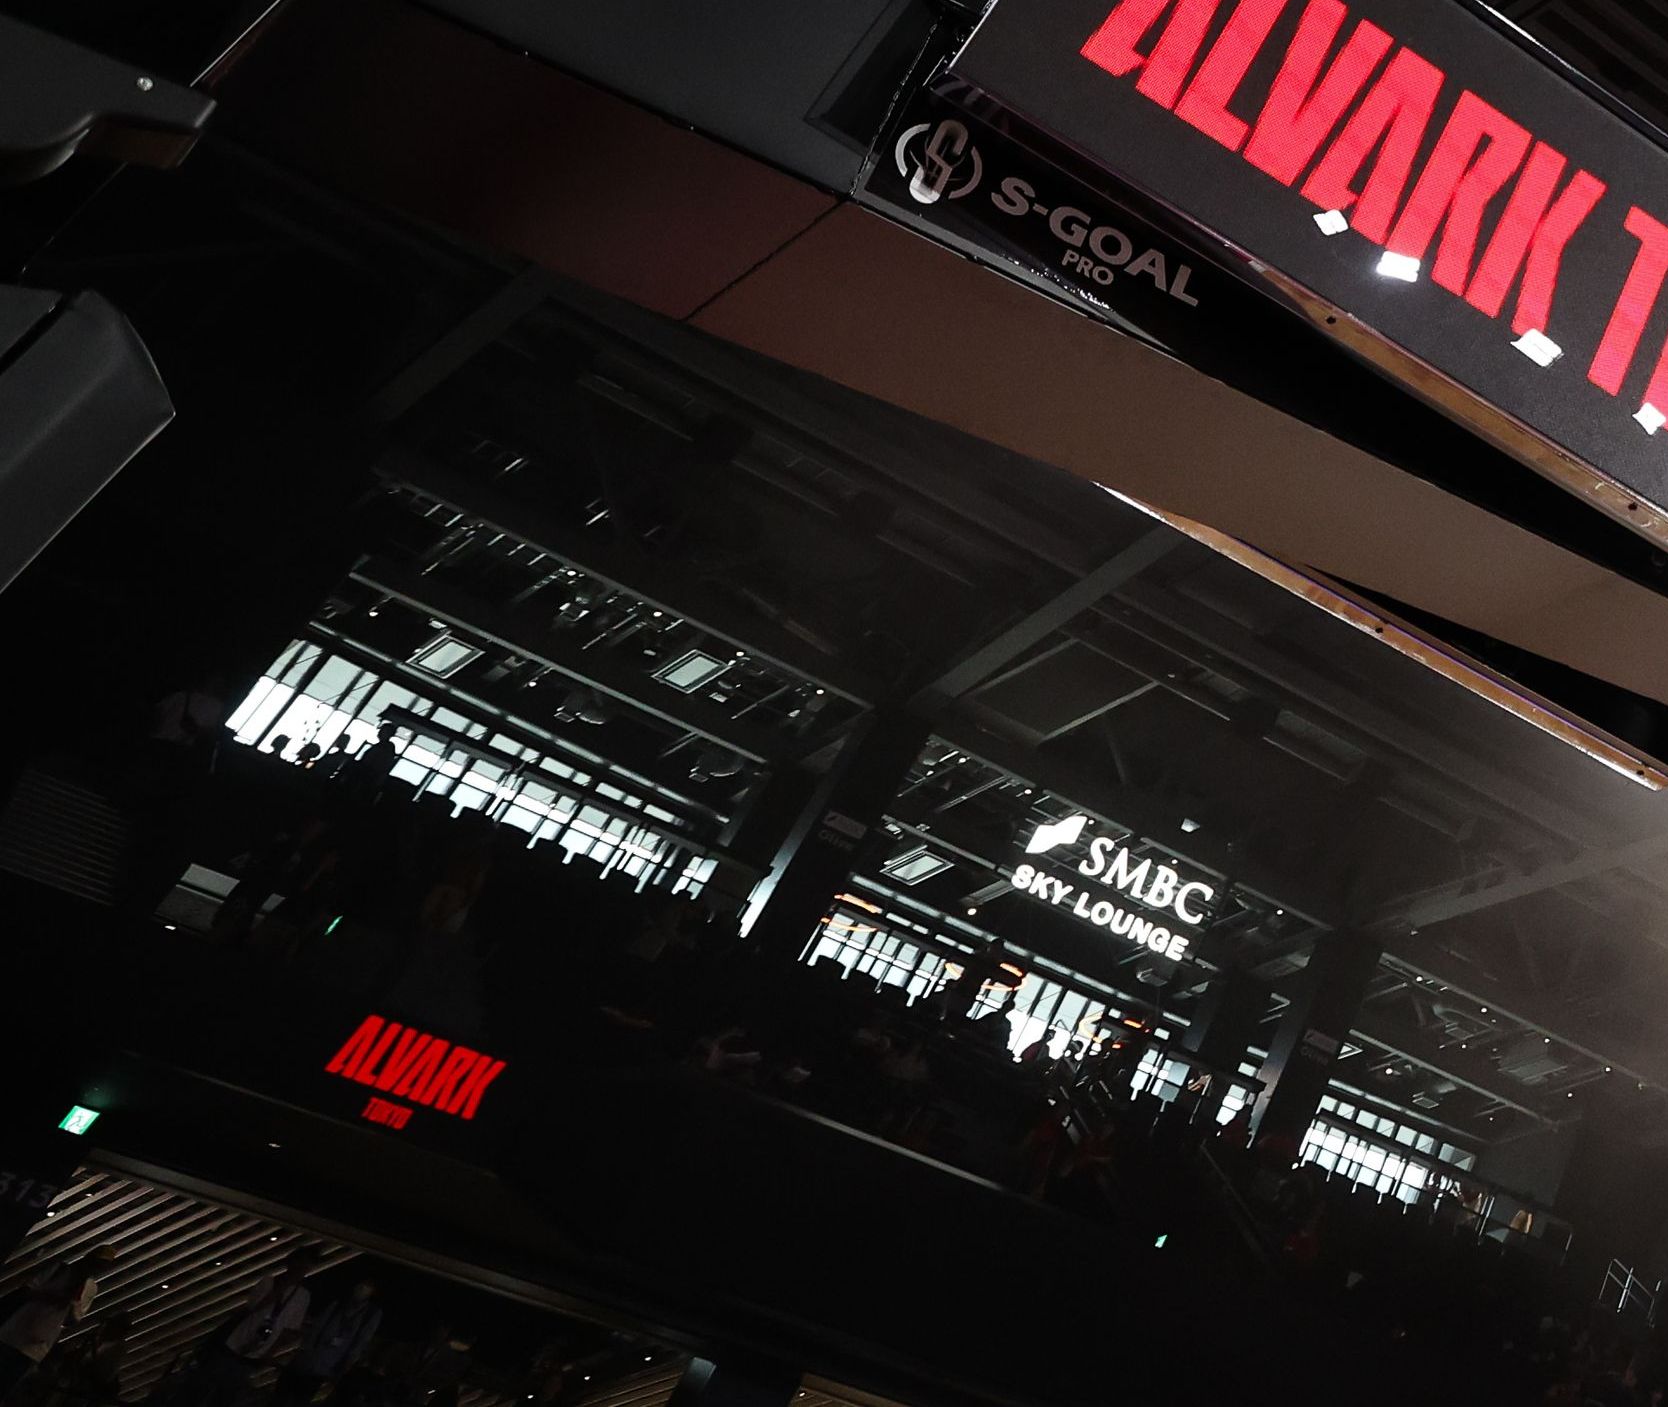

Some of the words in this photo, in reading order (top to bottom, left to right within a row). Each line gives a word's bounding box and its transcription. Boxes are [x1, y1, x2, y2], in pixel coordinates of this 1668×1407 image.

[991, 177, 1199, 307] S-GOAL
[1061, 249, 1115, 286] PRO
[1011, 865, 1074, 905] SKY
[1073, 892, 1189, 961] LOUNGE
[1079, 837, 1214, 924] SMBC
[325, 1014, 506, 1120] ALVARK
